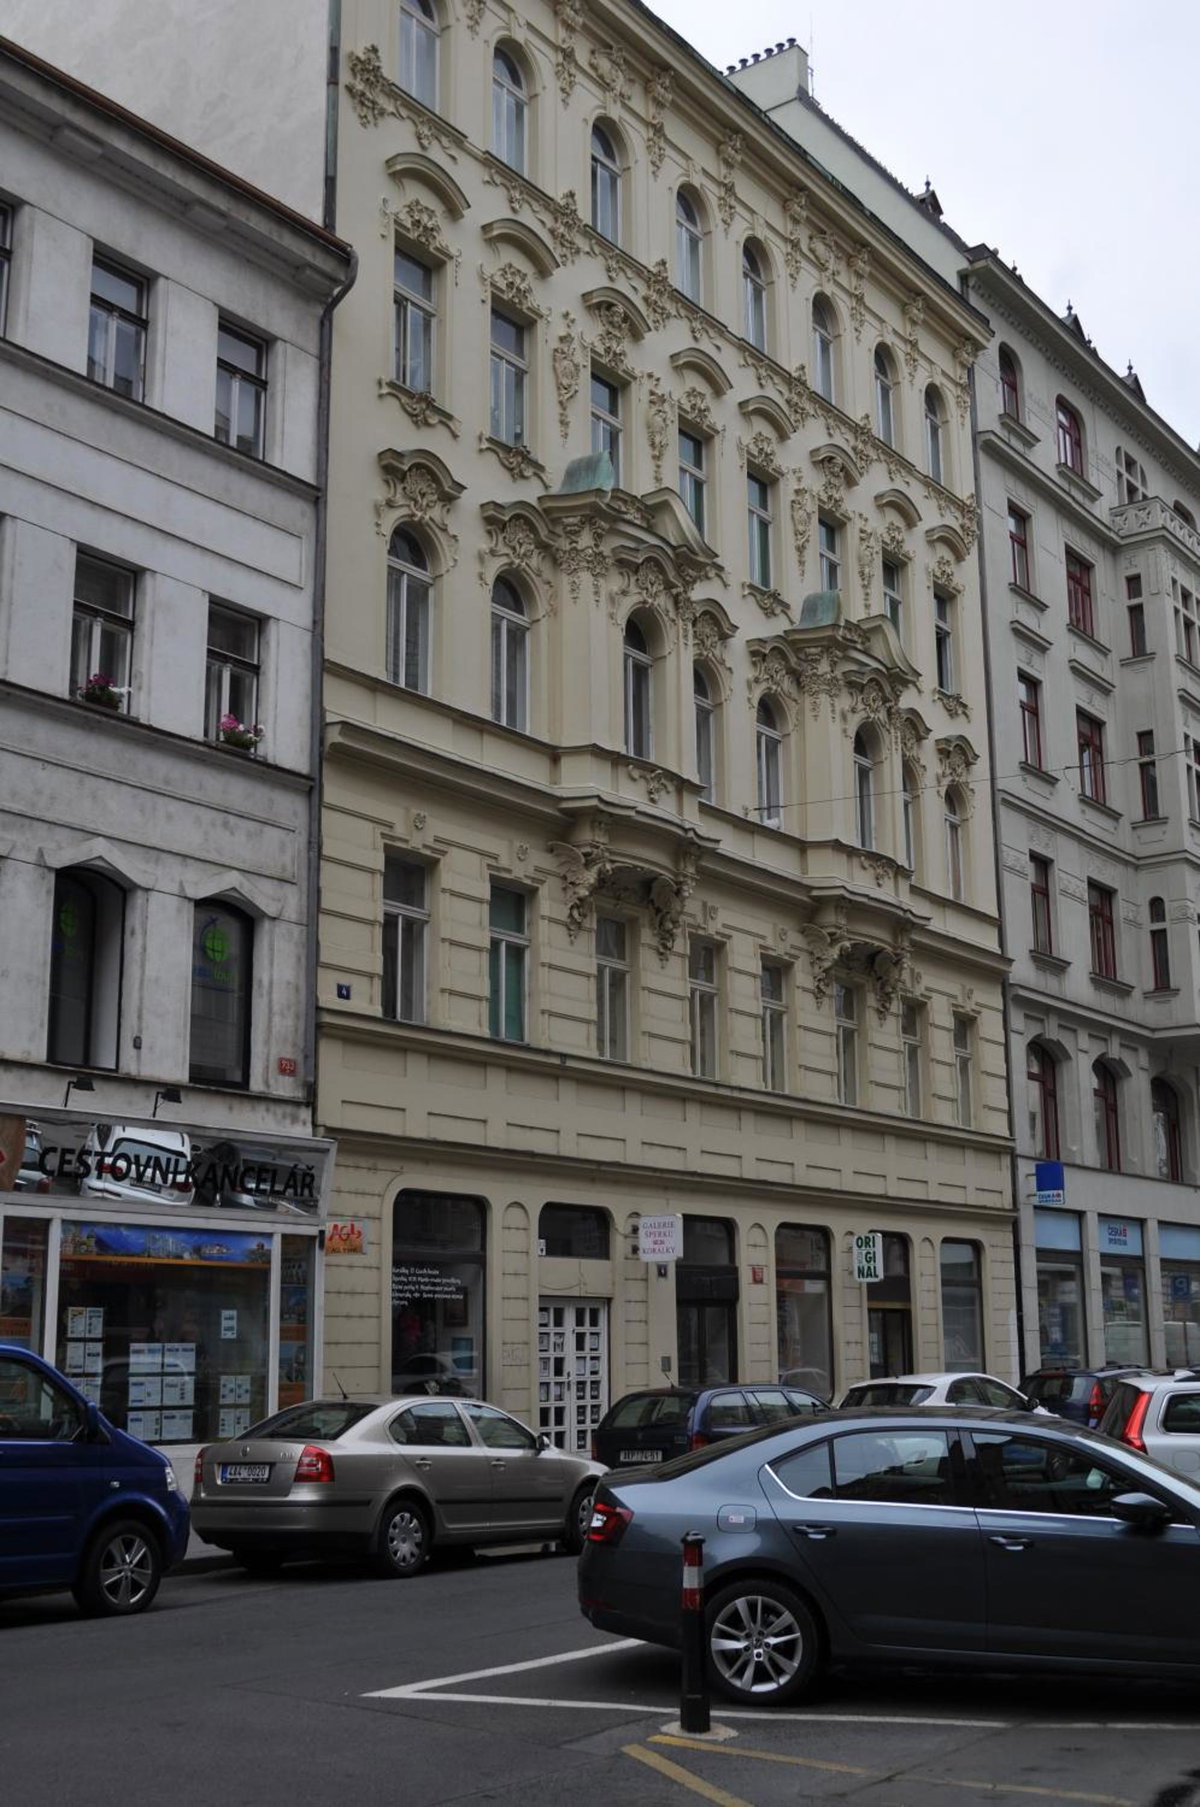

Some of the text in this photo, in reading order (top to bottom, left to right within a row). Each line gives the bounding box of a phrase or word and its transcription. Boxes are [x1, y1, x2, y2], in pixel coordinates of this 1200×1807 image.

[186, 1160, 315, 1198] KANCELÁŘ
[856, 1235, 876, 1249] ORI
[865, 1250, 876, 1264] GI
[857, 1265, 879, 1279] NAL
